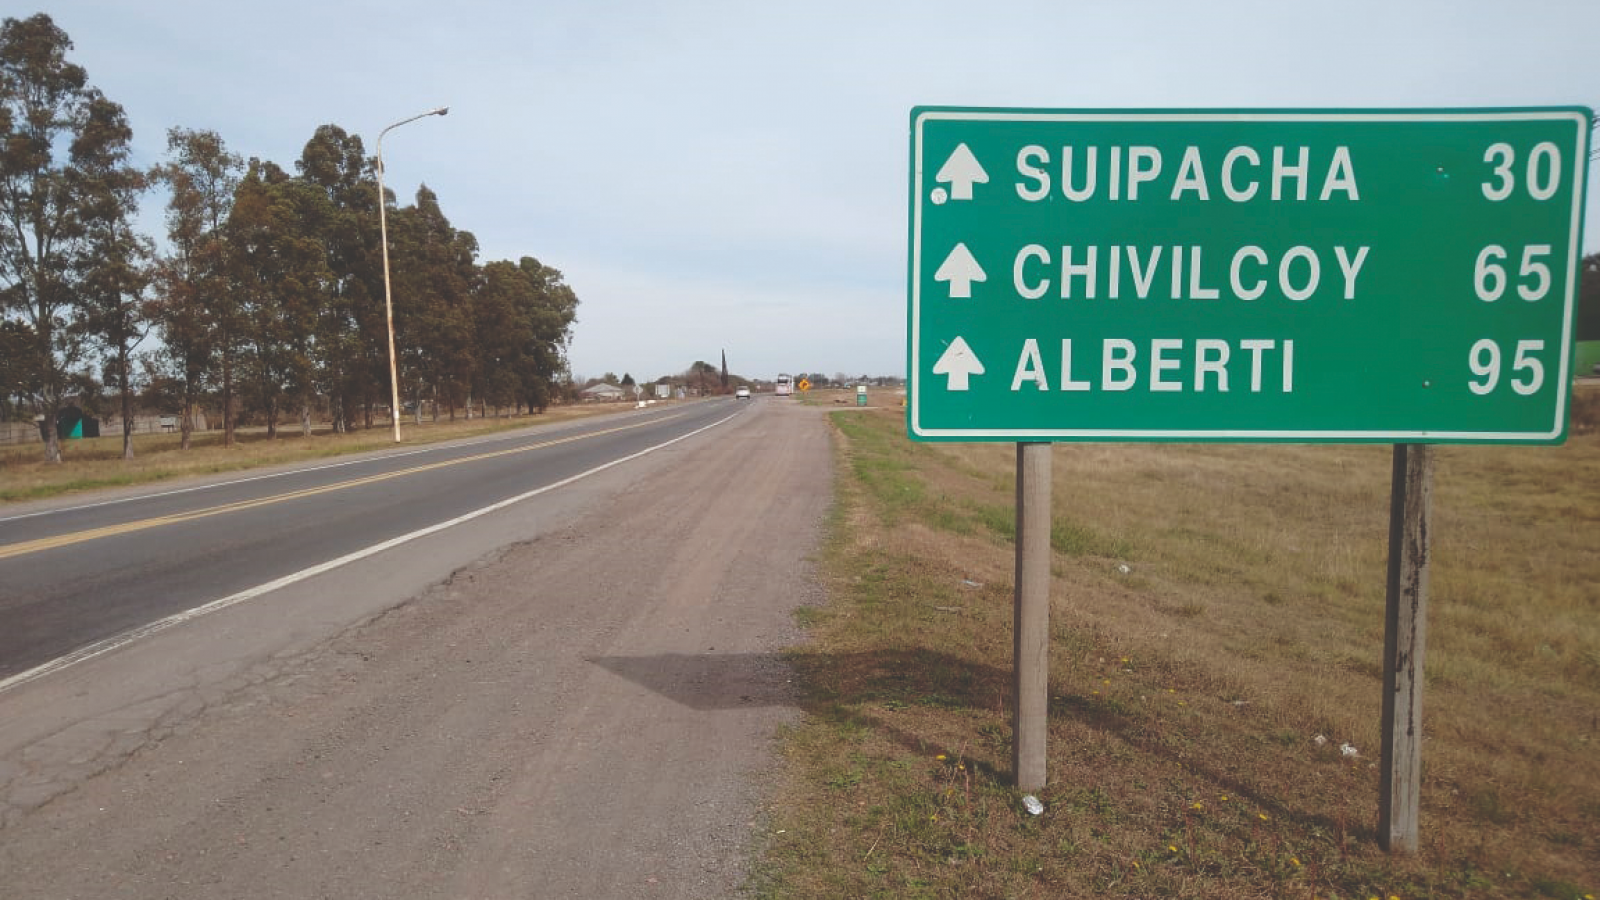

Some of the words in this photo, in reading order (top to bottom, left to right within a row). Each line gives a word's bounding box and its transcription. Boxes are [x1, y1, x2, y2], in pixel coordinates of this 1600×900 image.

[1014, 145, 1360, 202] SUIPACHA
[1481, 142, 1561, 202] 30
[1013, 243, 1370, 302] CHIVILCOY
[1473, 244, 1552, 304] 65
[1010, 337, 1294, 393] ALBERTI
[1468, 338, 1545, 397] 95
